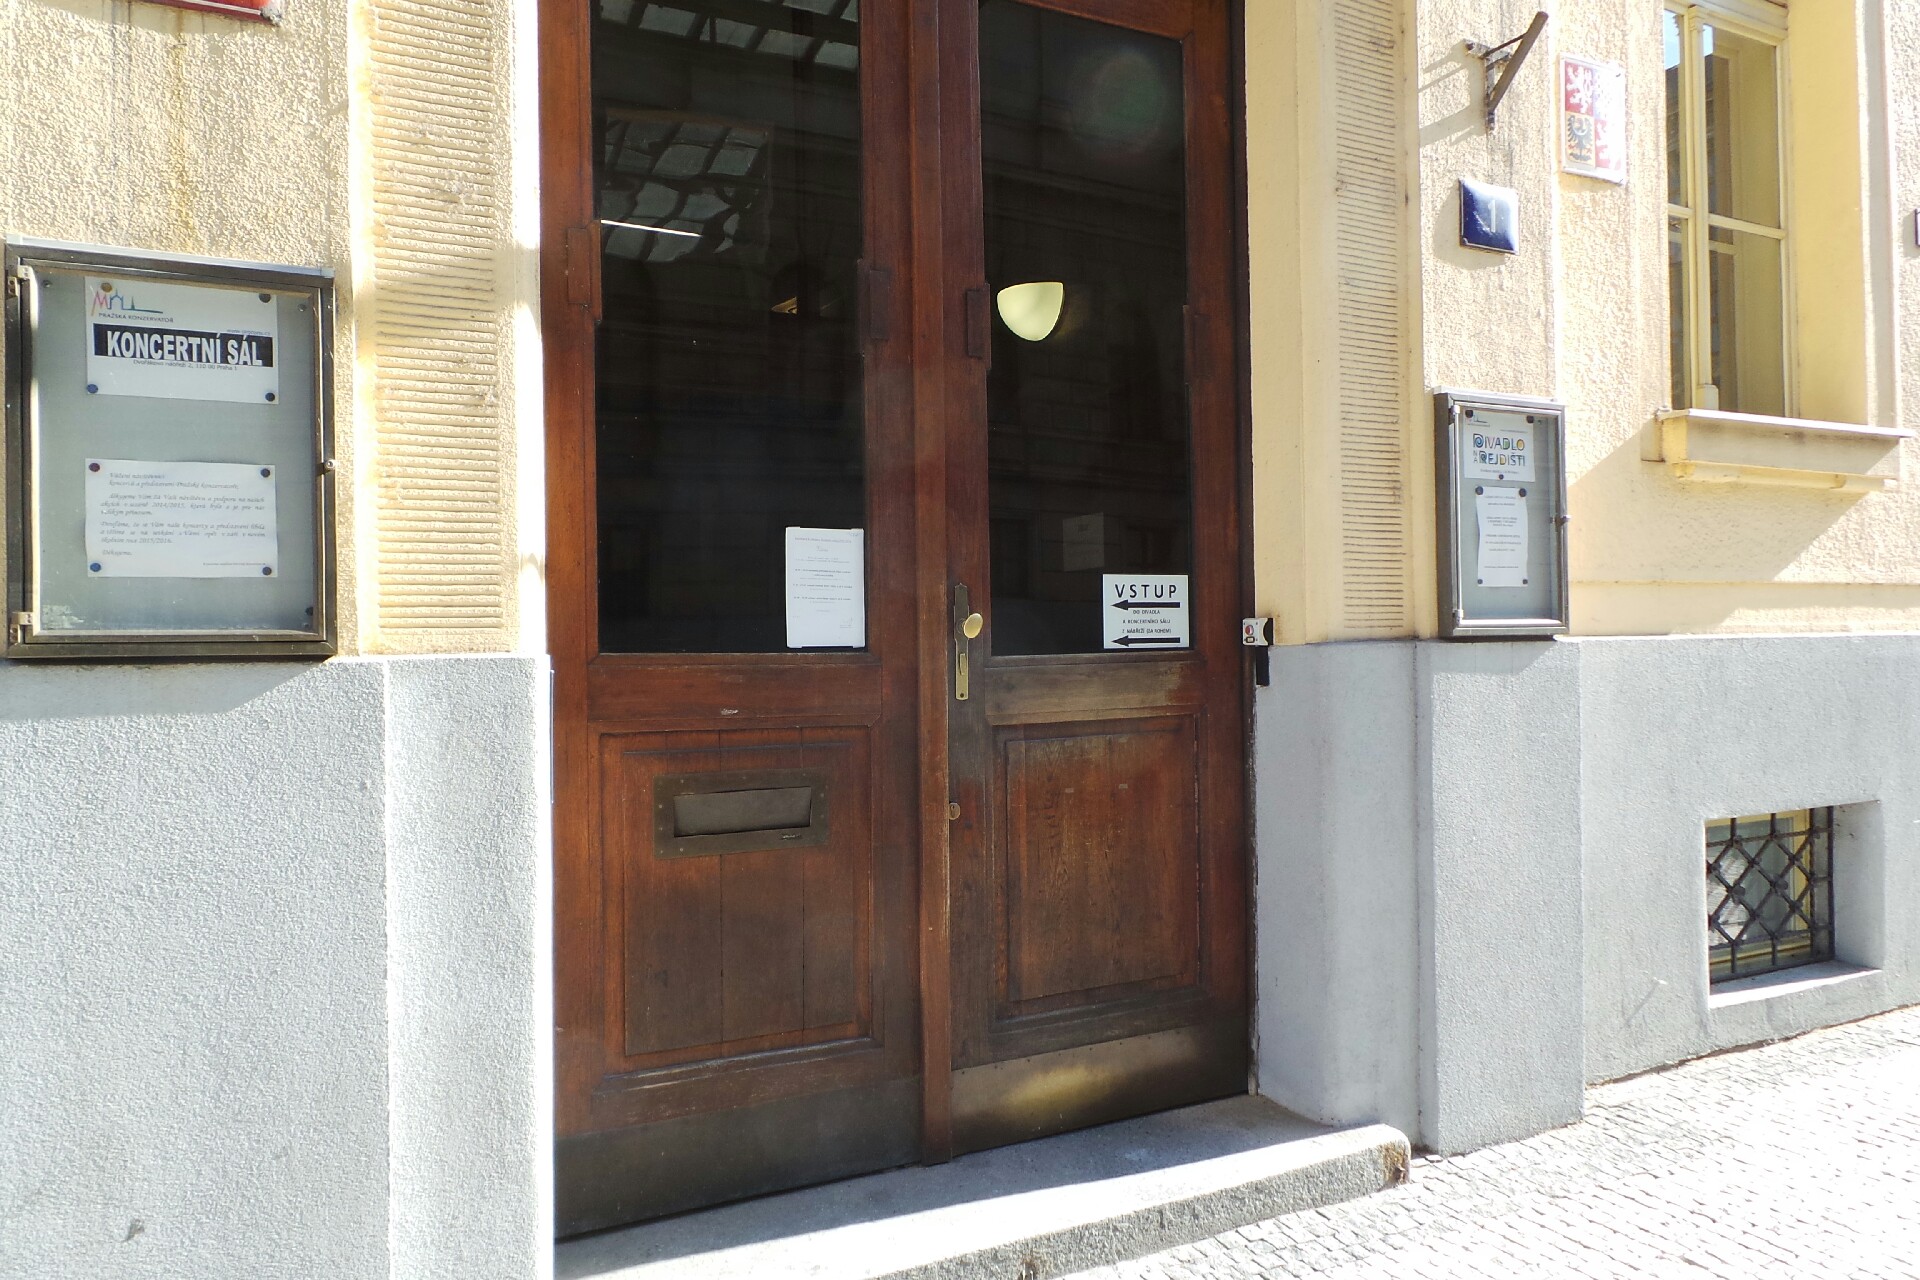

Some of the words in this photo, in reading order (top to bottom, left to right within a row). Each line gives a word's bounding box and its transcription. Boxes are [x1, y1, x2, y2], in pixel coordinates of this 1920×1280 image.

[1487, 199, 1496, 233] 1
[107, 330, 221, 364] KONCERTNÍ
[227, 335, 263, 366] SÁL
[1473, 433, 1525, 452] DIVADLO
[1114, 583, 1177, 599] VSTUP
